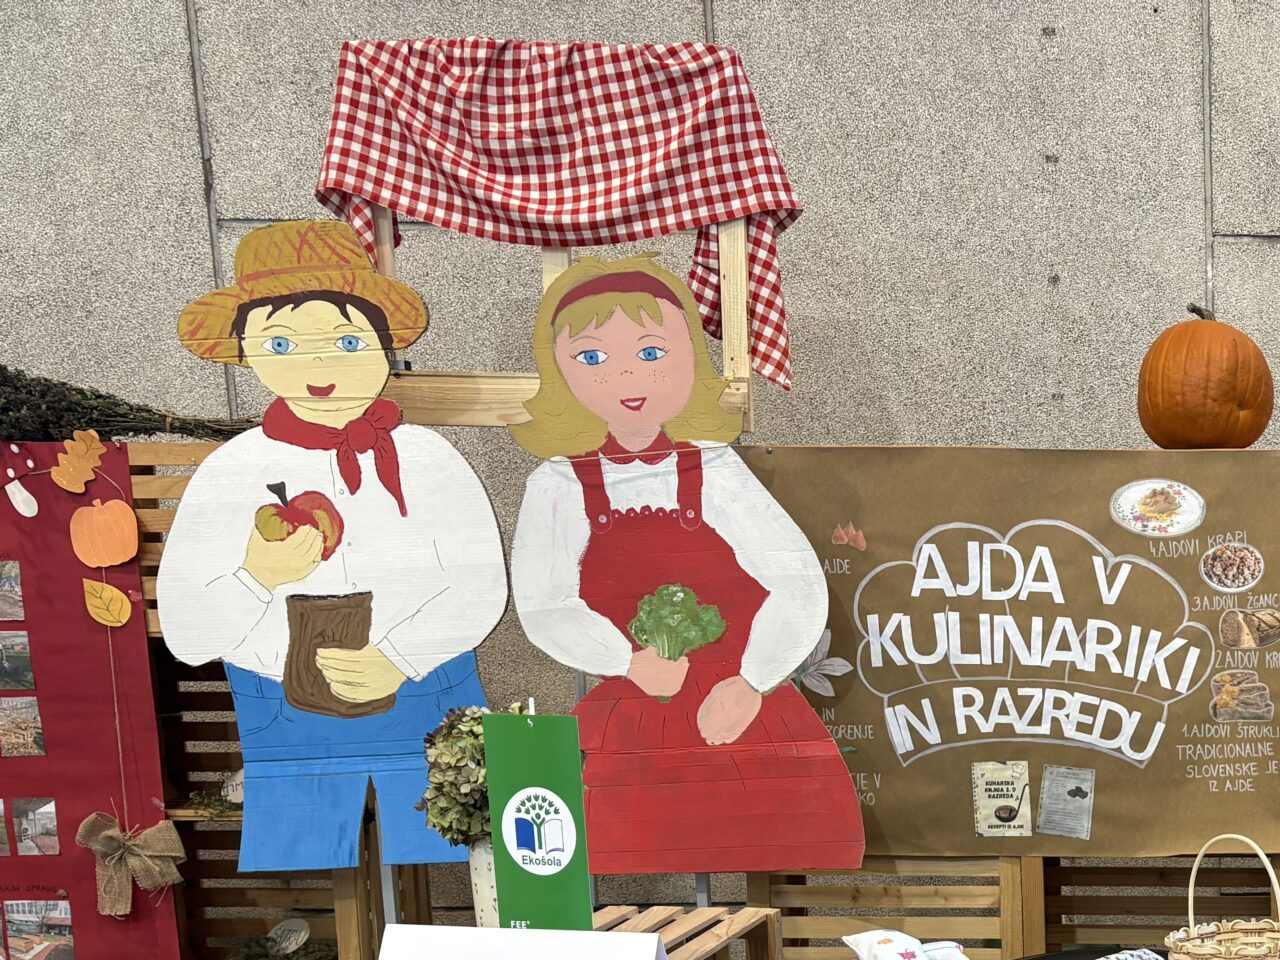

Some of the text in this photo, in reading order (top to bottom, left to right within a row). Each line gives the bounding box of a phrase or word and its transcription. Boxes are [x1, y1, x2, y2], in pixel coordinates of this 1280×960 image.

[911, 541, 1132, 605] AJDA V
[866, 611, 1201, 694] KULINARIKI
[884, 687, 1166, 762] IN RAZREDU
[1176, 742, 1275, 761] TRADICIONALNE
[1185, 762, 1259, 778] SLOVENSKE
[1209, 779, 1255, 792] IZ AJDE
[521, 854, 562, 867] Ekošola
